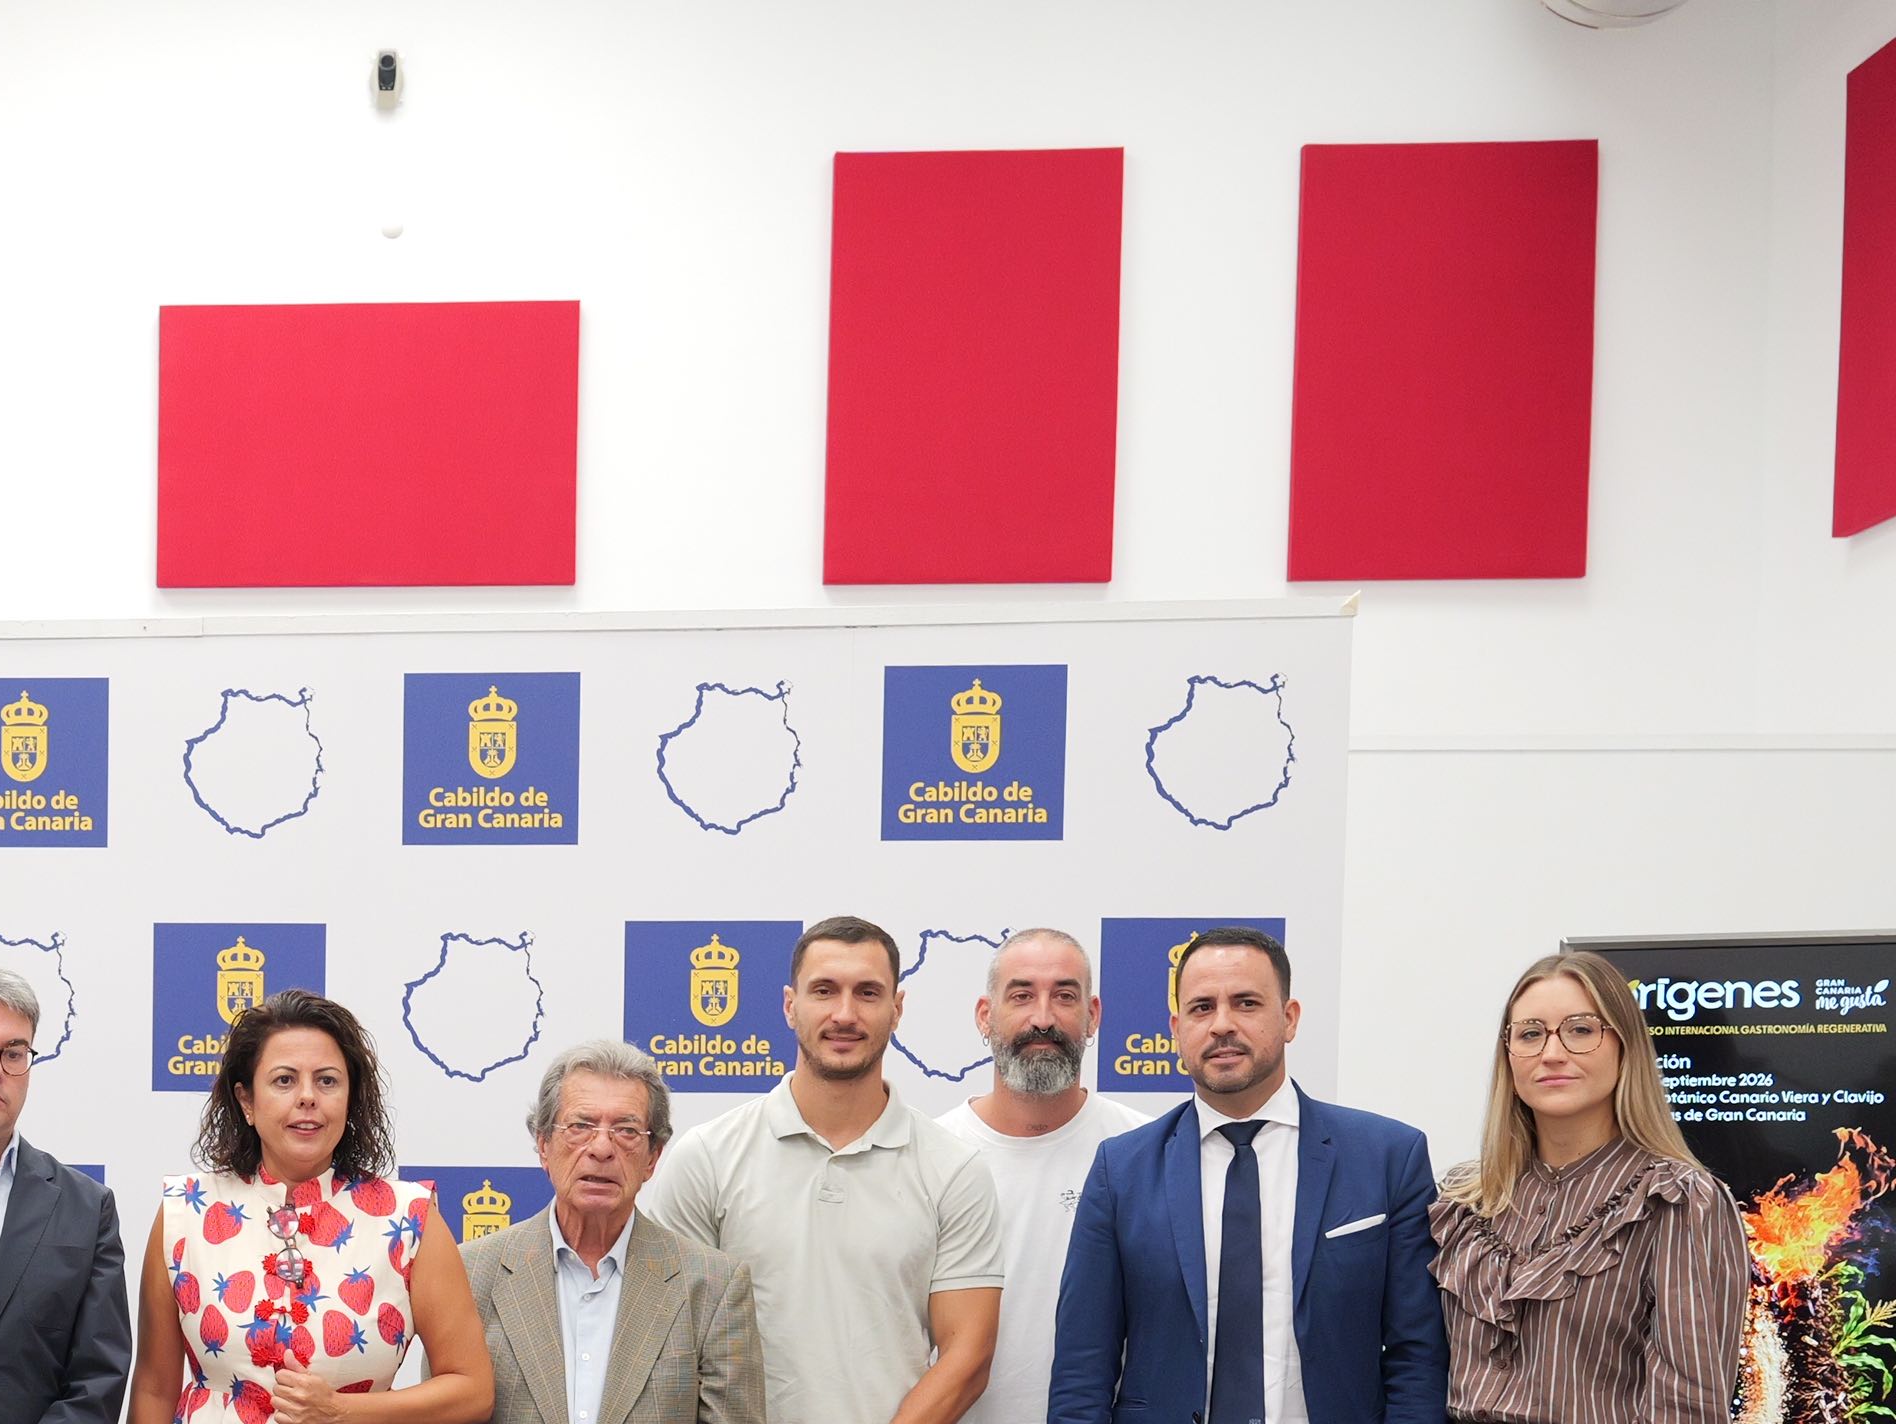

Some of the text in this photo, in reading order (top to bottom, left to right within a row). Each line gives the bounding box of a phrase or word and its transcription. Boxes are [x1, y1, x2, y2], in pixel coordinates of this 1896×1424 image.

[51, 790, 79, 810] de
[429, 786, 548, 807] Cabildo de
[909, 781, 1033, 802] Cabildo de
[10, 811, 93, 830] Canaria
[418, 808, 563, 828] Gran Canaria
[898, 803, 1048, 823] Gran Canaria
[1815, 979, 1845, 987] GRAN
[1815, 986, 1863, 995] CANARIA
[1815, 986, 1887, 1016] me gusta
[1664, 1025, 1739, 1036] INTERNACIONAL
[1740, 1022, 1816, 1035] GASTRONOMÍA
[1817, 1023, 1888, 1034] REGENERATIVA
[177, 1034, 227, 1054] Cabi
[649, 1034, 770, 1055] Cabildo de
[1125, 1033, 1177, 1053] Cabi
[653, 1056, 785, 1076] ran Canaria
[1114, 1055, 1171, 1075] Gran
[1662, 1073, 1774, 1089] eptiembre 2026
[1664, 1090, 1885, 1106] otánico Canario Viera y Clavijo
[1683, 1108, 1704, 1122] de
[1705, 1108, 1744, 1122] Gran
[1745, 1108, 1807, 1122] Canaria
